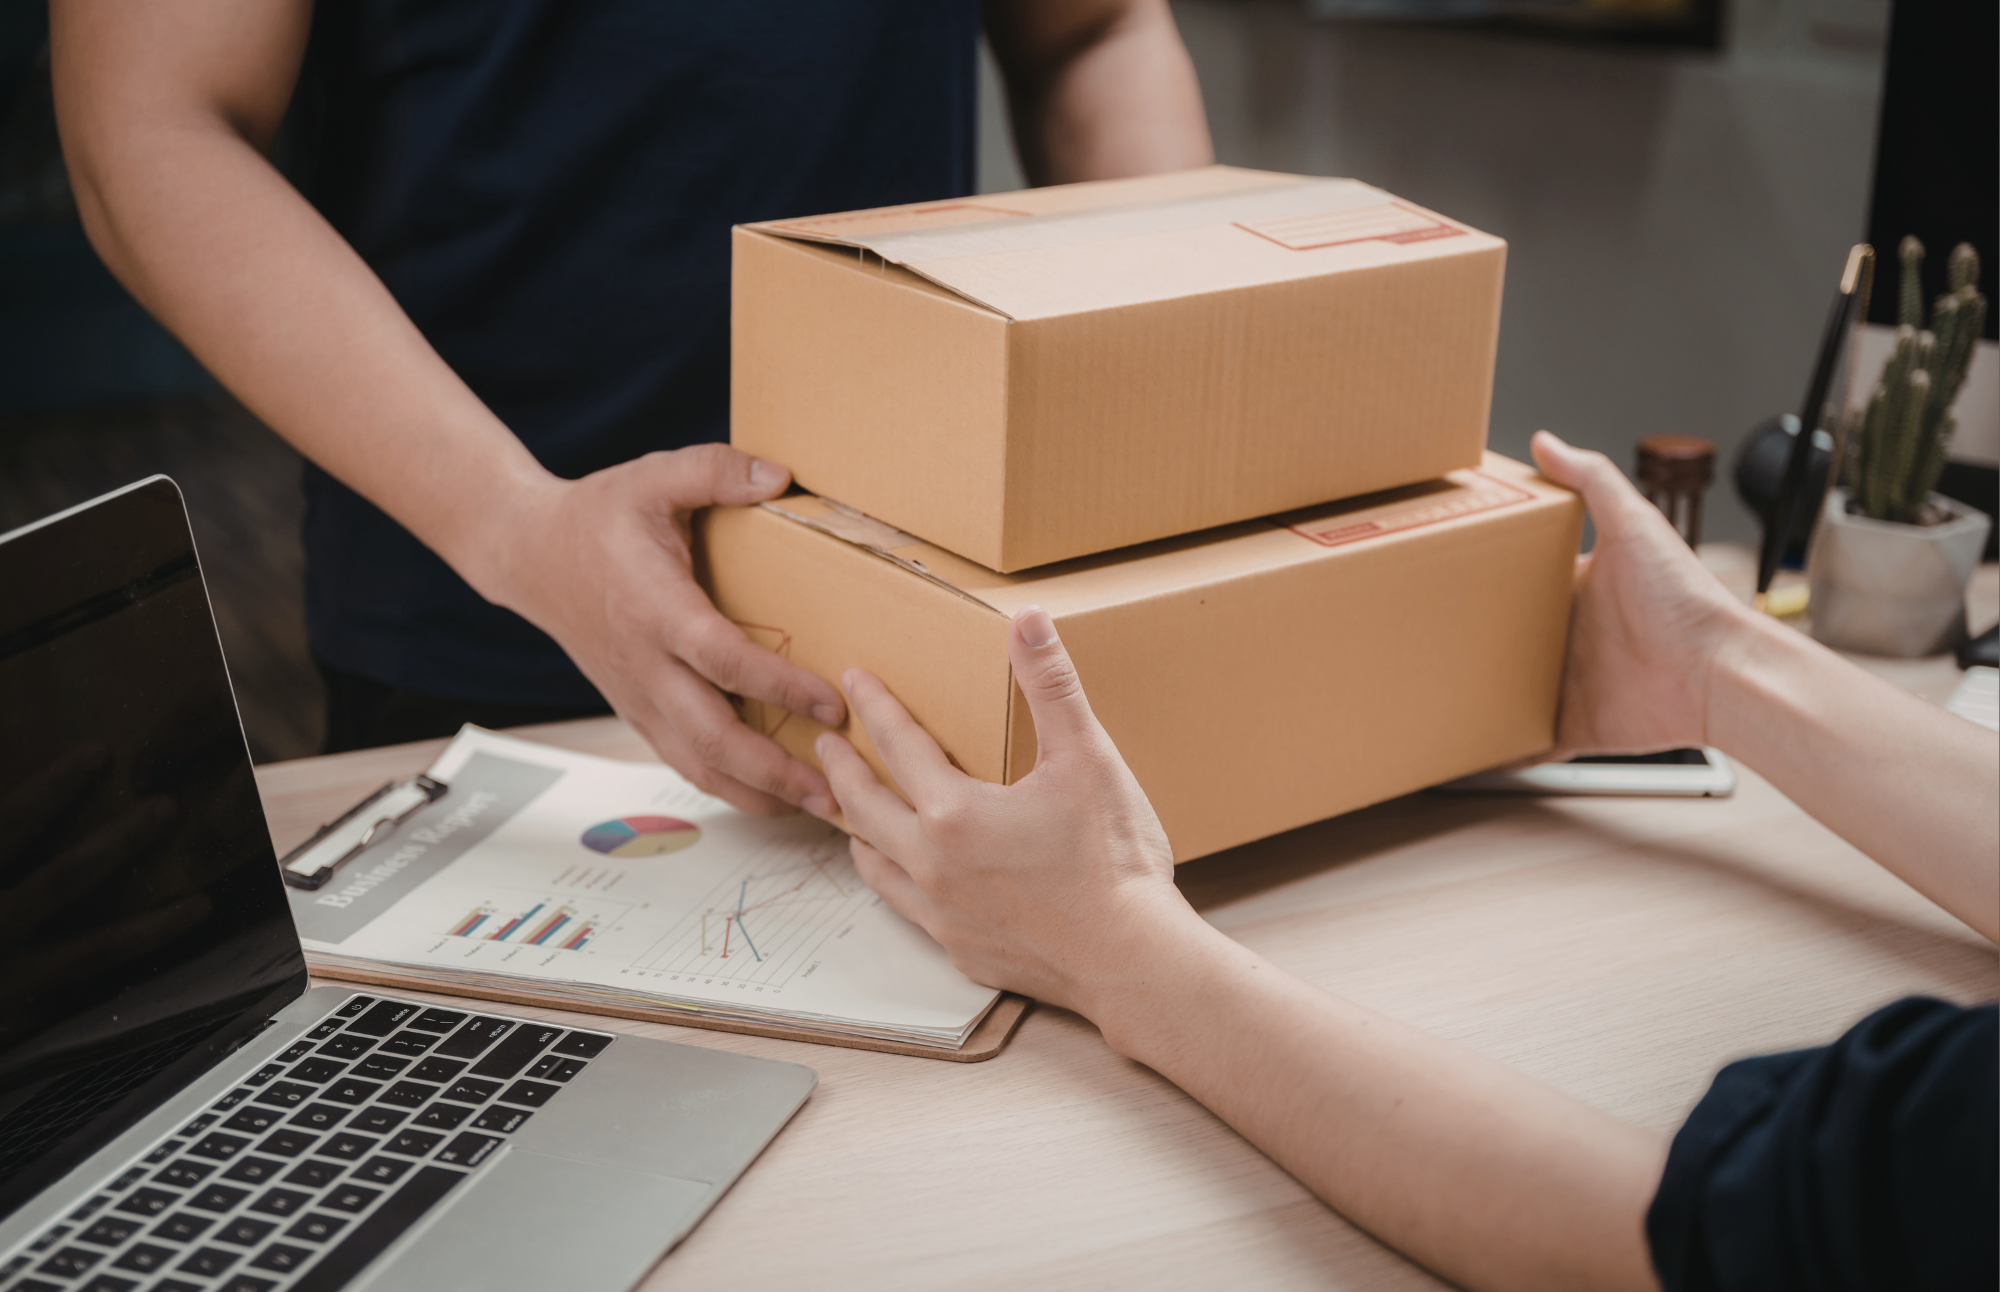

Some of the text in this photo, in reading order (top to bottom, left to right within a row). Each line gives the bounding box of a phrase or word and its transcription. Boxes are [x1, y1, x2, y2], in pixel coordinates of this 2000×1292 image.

[315, 791, 498, 908] Business Report
[801, 964, 818, 978] Product
[392, 1009, 409, 1021] delete
[489, 1024, 506, 1038] return
[539, 1032, 553, 1043] shift
